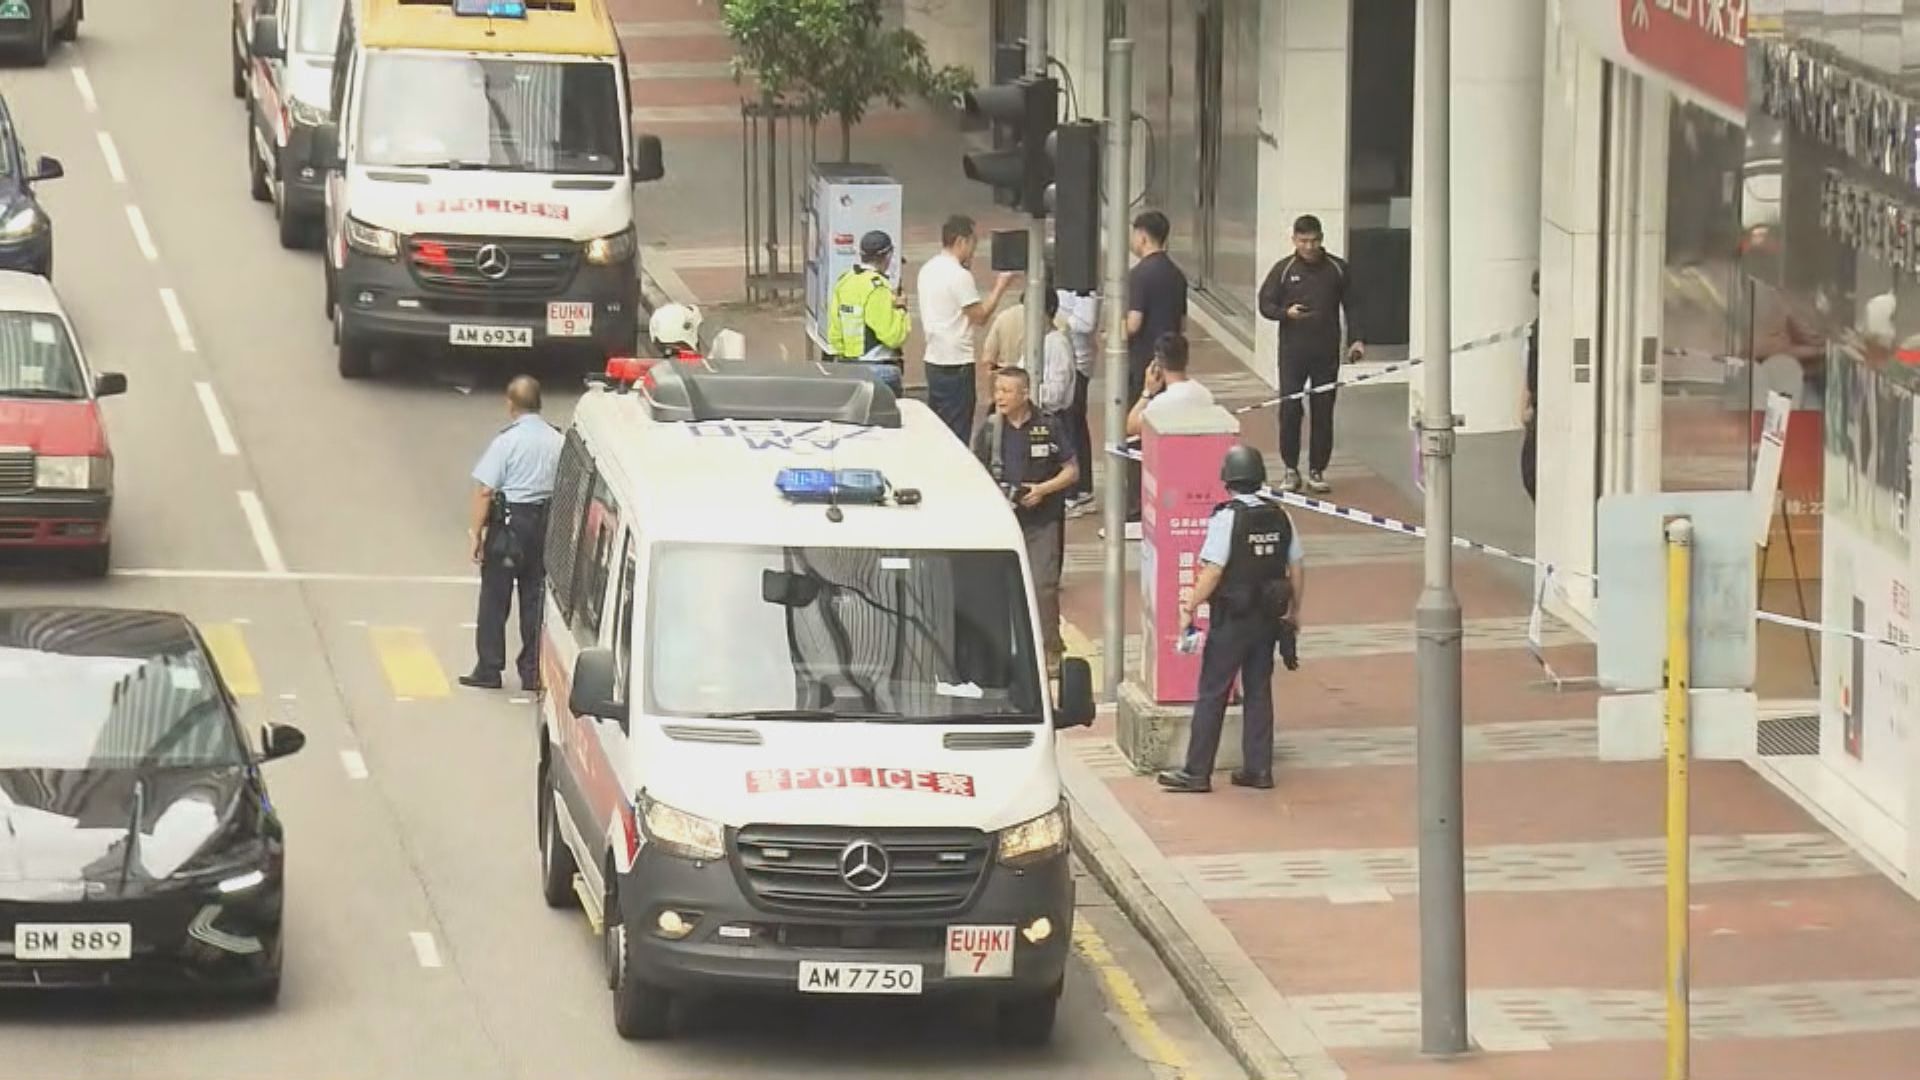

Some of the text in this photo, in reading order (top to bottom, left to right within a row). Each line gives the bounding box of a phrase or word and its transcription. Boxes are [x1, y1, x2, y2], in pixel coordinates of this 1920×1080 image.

[456, 329, 527, 344] AM 6934
[565, 321, 575, 335] 9
[25, 932, 121, 950] BM 889
[950, 930, 1009, 951] EUHKI
[972, 953, 987, 973] 7
[808, 968, 914, 988] AM 7750
